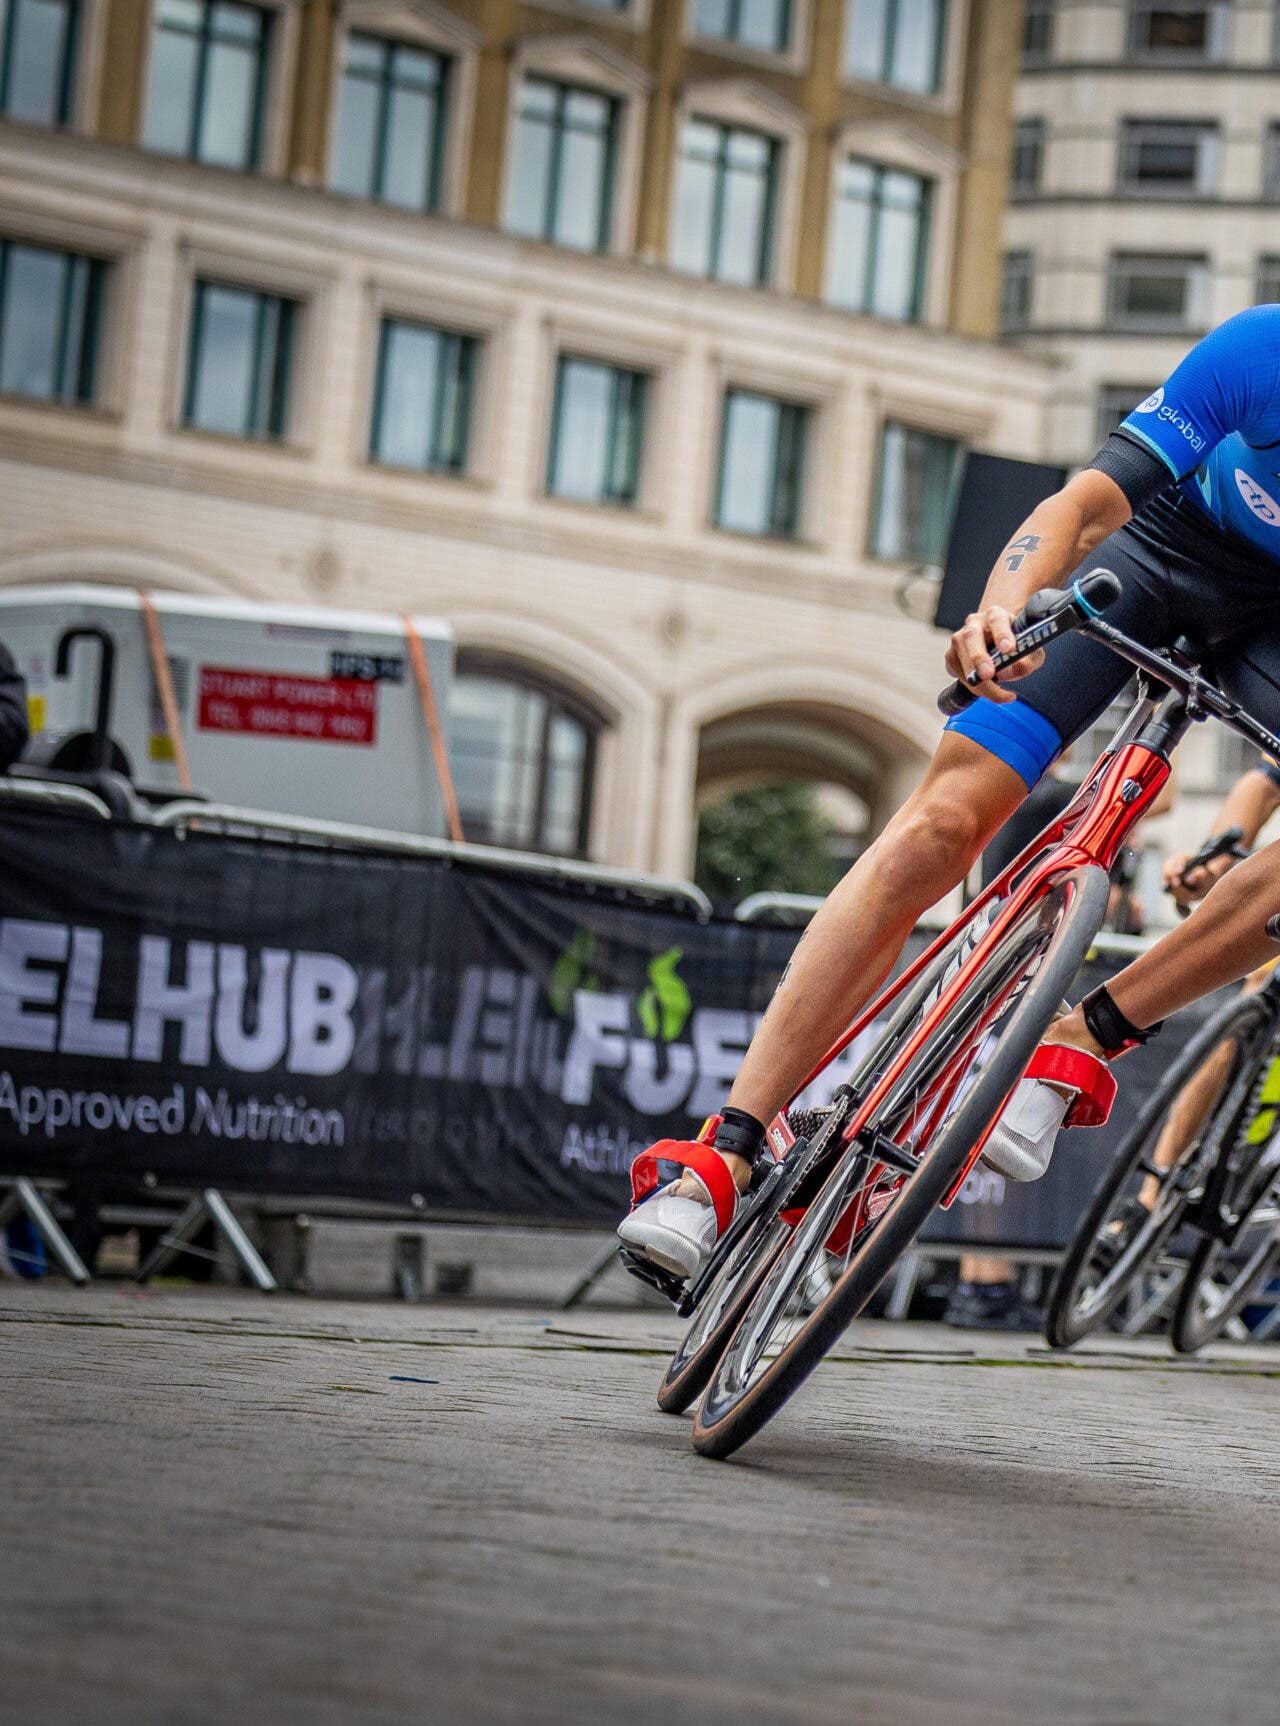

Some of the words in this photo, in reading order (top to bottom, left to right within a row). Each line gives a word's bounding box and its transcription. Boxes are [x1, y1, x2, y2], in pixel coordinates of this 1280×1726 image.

[1157, 405, 1206, 453] global
[1240, 479, 1275, 520] rtp
[0, 918, 358, 1077] ELHUB
[561, 988, 766, 1118] FUE
[0, 1070, 185, 1138] Approved
[190, 1084, 345, 1147] Nutrition
